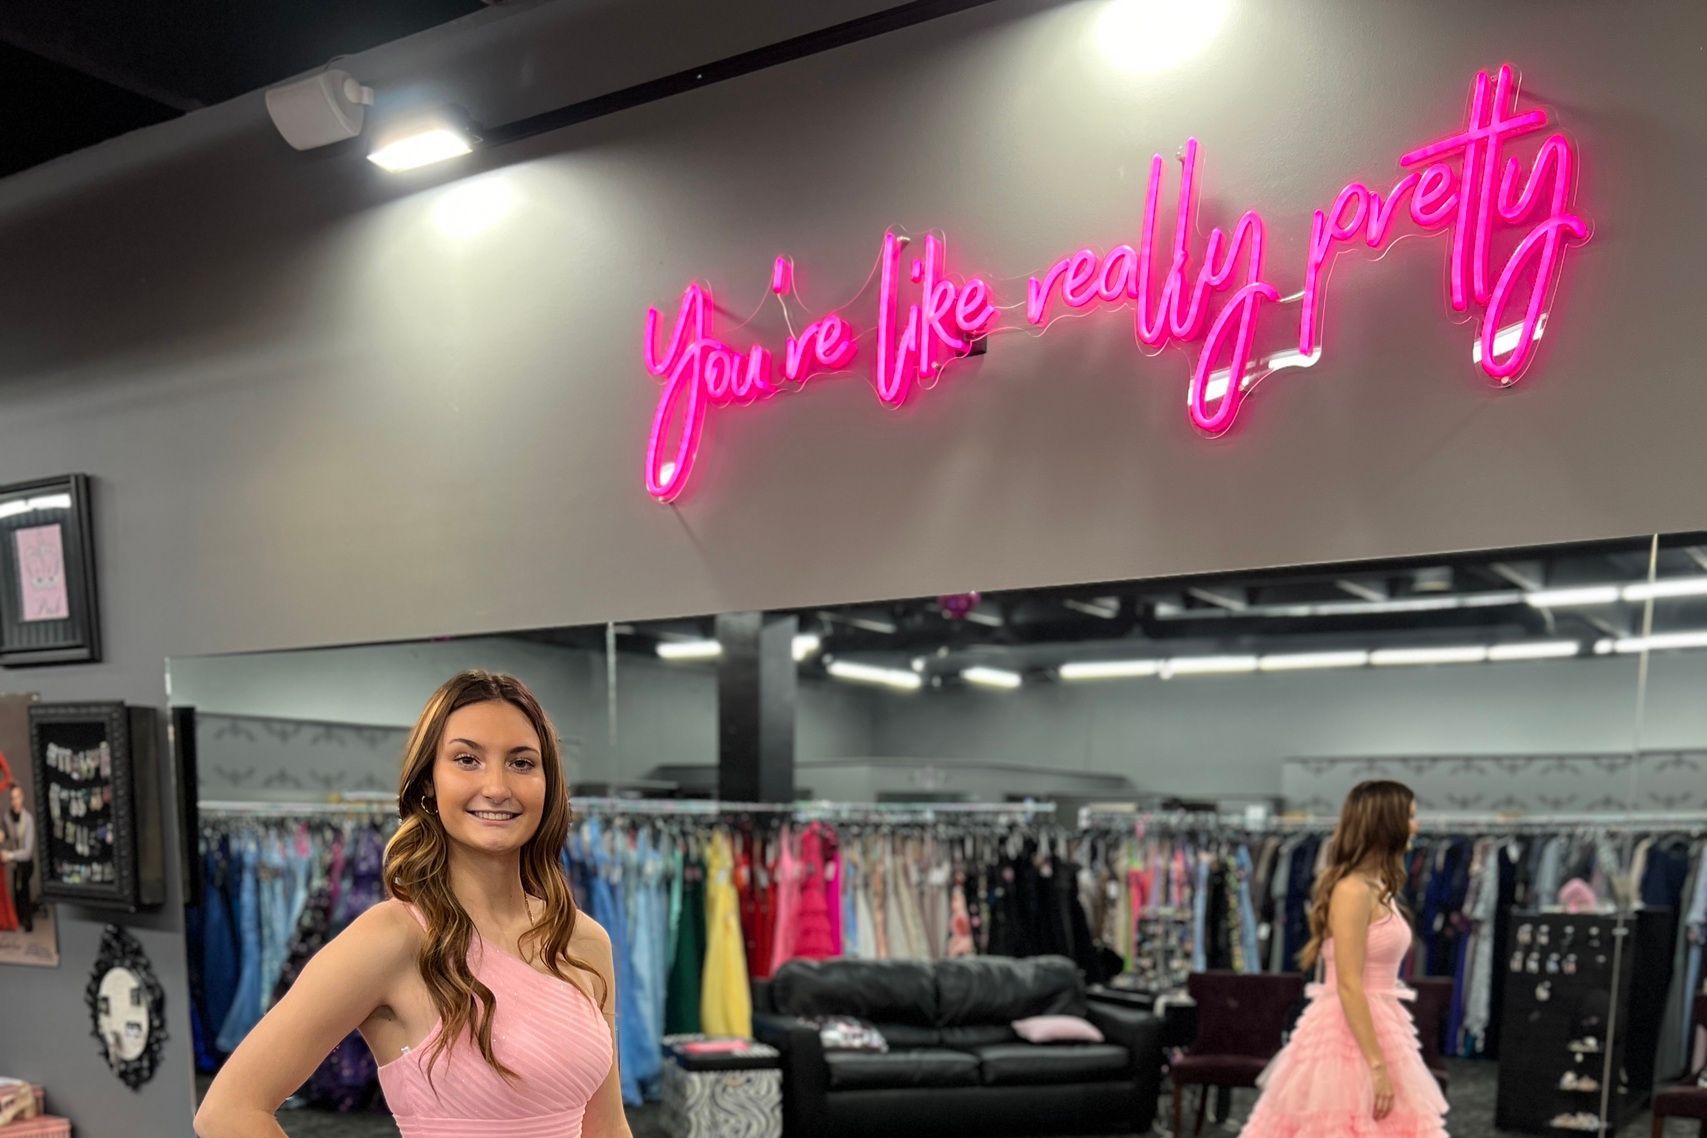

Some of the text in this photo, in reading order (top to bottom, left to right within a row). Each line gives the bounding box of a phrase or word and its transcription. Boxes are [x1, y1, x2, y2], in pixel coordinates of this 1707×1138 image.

[643, 63, 1590, 500] You're like really pretty
